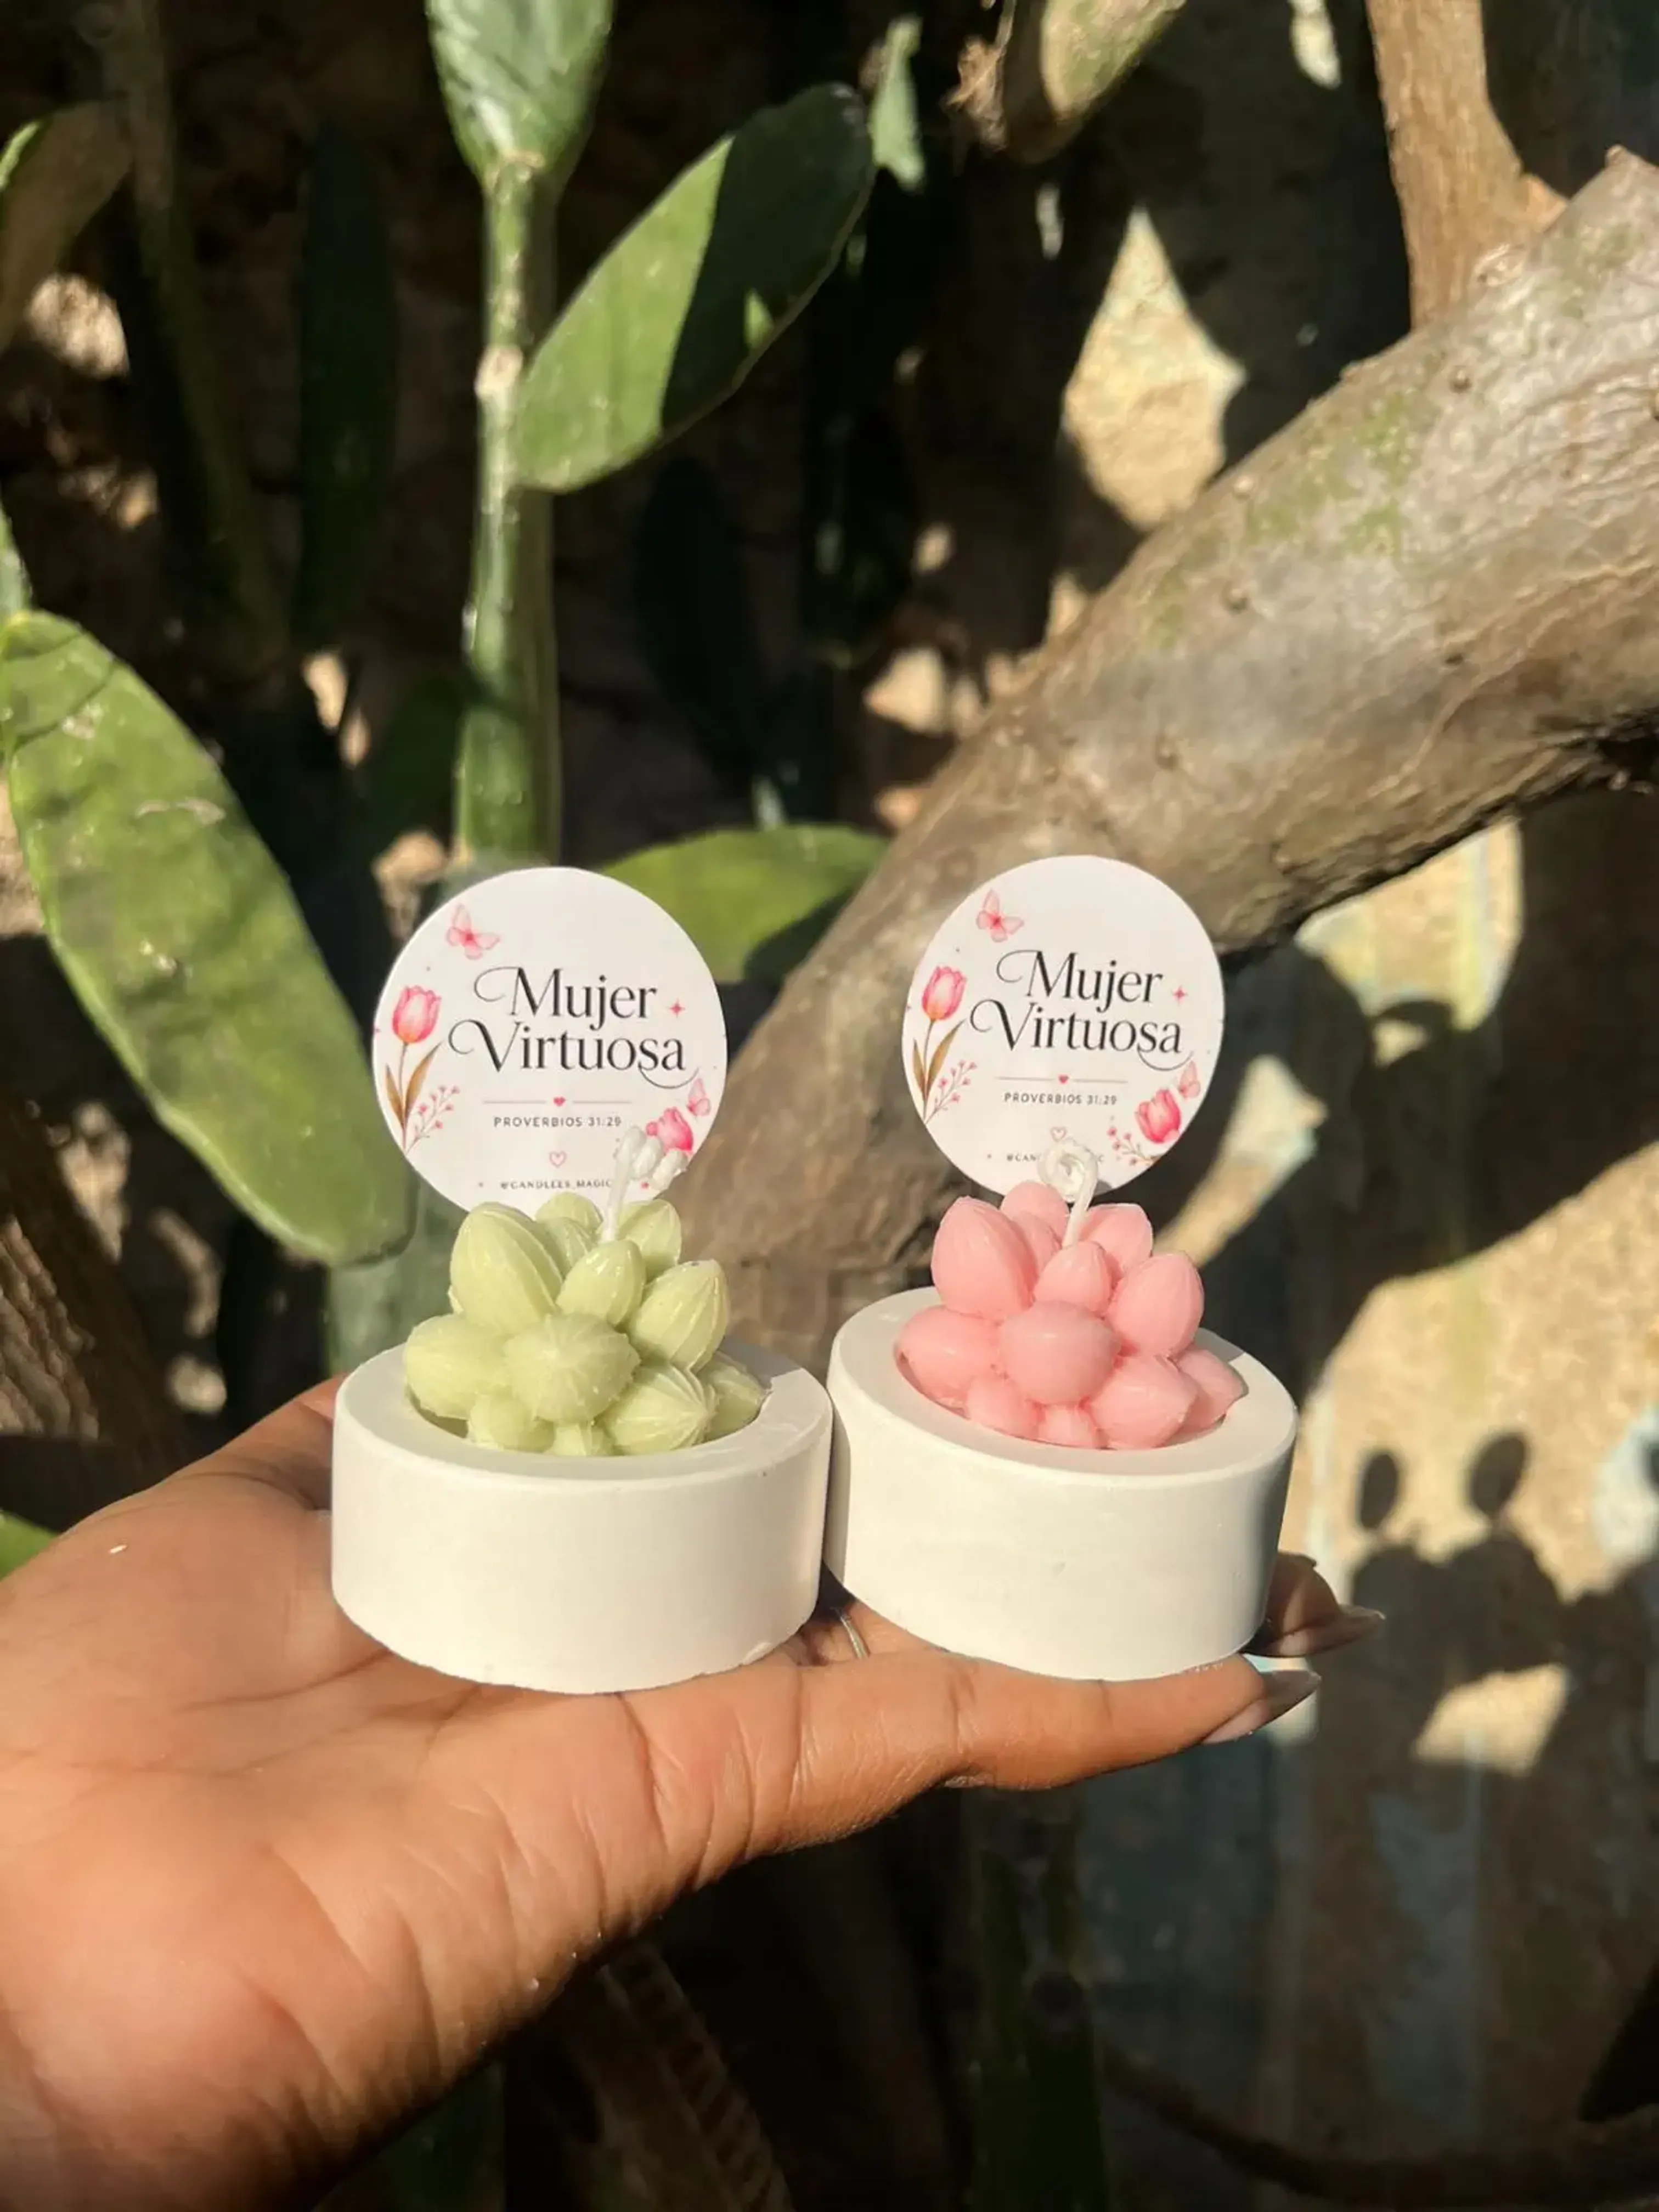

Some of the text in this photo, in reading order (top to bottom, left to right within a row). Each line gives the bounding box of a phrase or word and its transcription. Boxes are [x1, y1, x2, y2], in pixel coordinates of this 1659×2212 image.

[474, 966, 658, 1030] Mujer
[996, 950, 1164, 1013] Mujer
[448, 1019, 699, 1090] Virtuosa
[969, 999, 1194, 1071] Virtuosa
[494, 1116, 622, 1127] PROVERBIOS 31:29
[1004, 1091, 1118, 1106] PROVERBIOS 31:29
